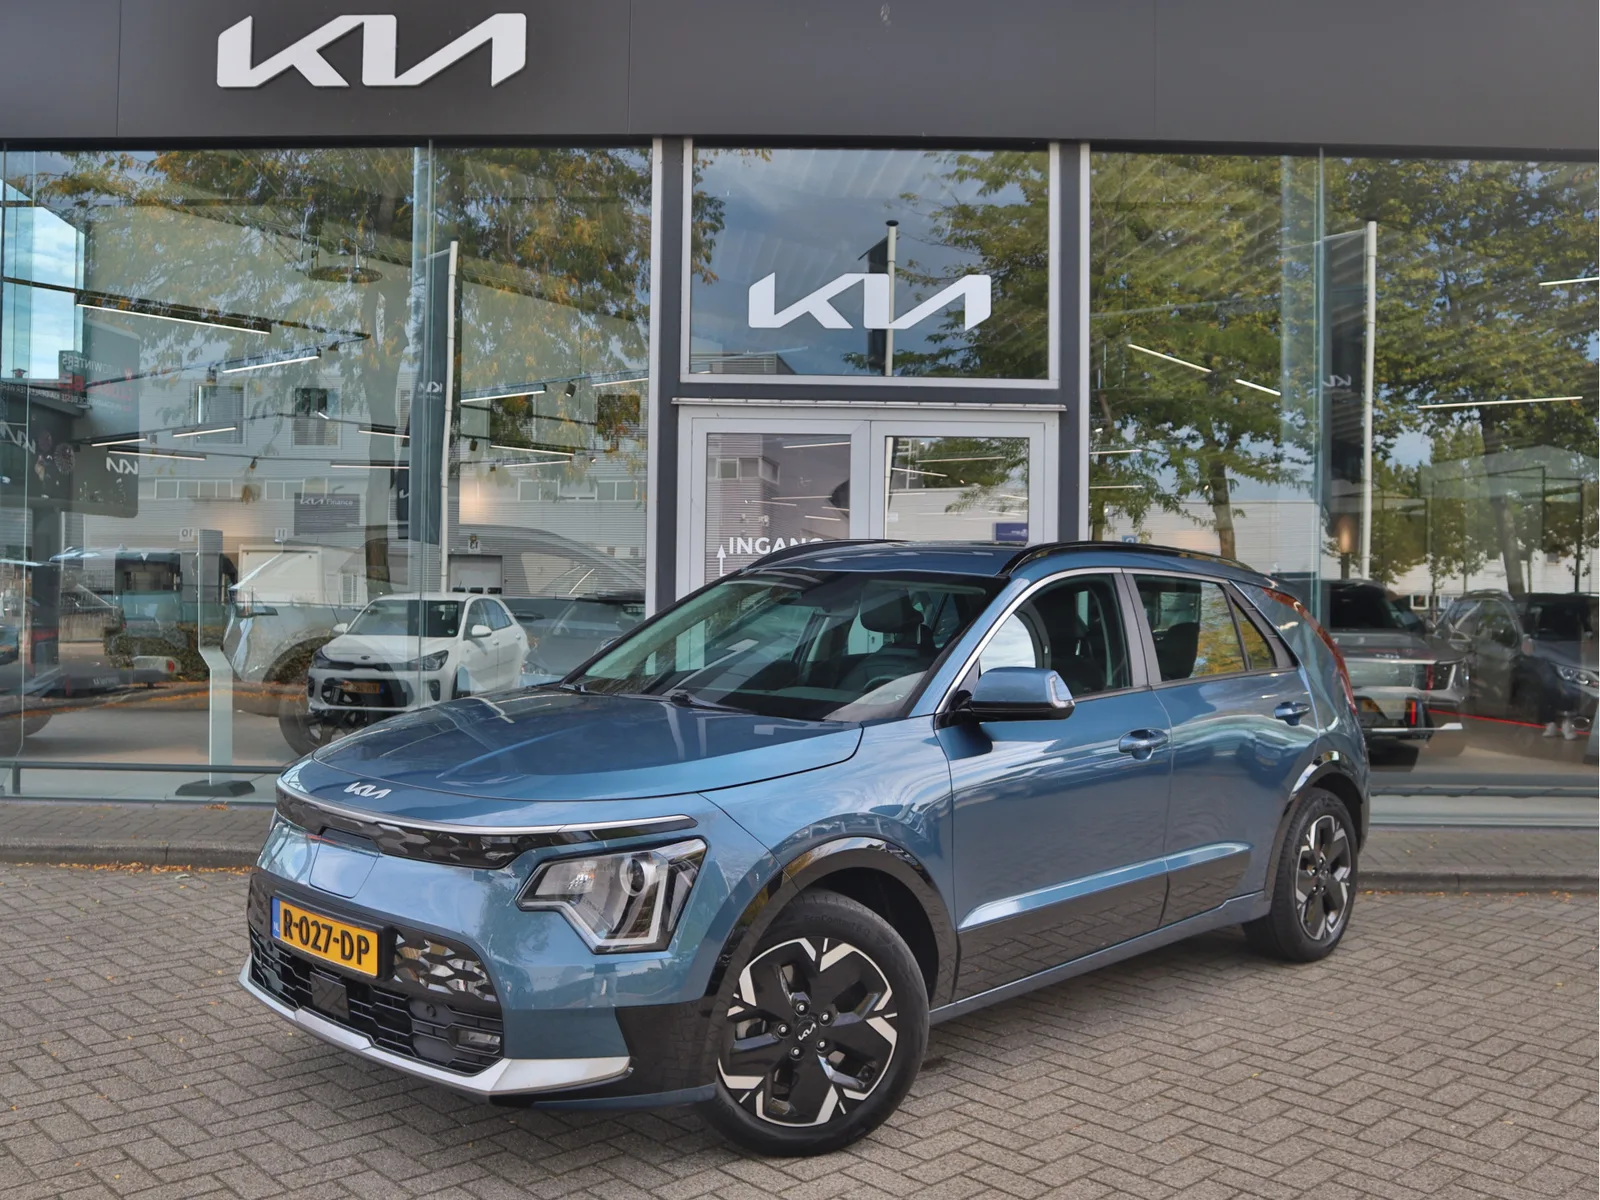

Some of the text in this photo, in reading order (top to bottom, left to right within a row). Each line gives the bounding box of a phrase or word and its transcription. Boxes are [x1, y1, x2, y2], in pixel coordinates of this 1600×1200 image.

[217, 13, 527, 88] KIA
[748, 272, 992, 331] KIA
[729, 536, 824, 555] INGA
[343, 781, 393, 799] KIA
[283, 909, 370, 965] R-027-DP
[798, 1022, 818, 1041] KIA
